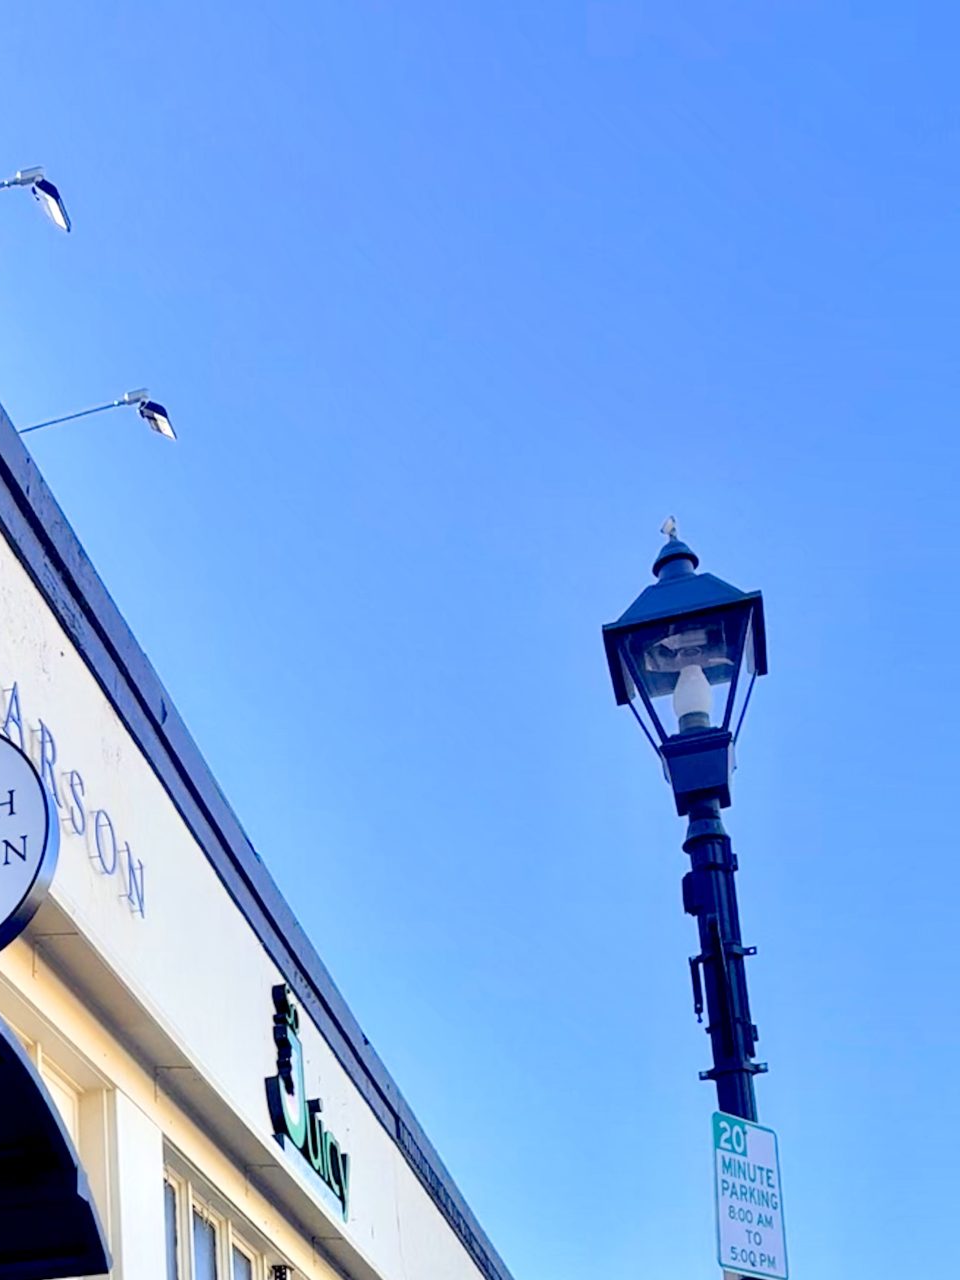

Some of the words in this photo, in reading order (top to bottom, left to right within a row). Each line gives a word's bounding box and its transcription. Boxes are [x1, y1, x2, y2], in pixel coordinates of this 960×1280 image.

[718, 1120, 746, 1154] 20
[721, 1155, 775, 1188] MINUTE
[721, 1179, 779, 1210] PARKING
[728, 1205, 753, 1224] 8:00
[756, 1213, 774, 1229] AM
[746, 1229, 762, 1246] TO
[730, 1246, 757, 1267] 5:00
[759, 1254, 776, 1269] PM
